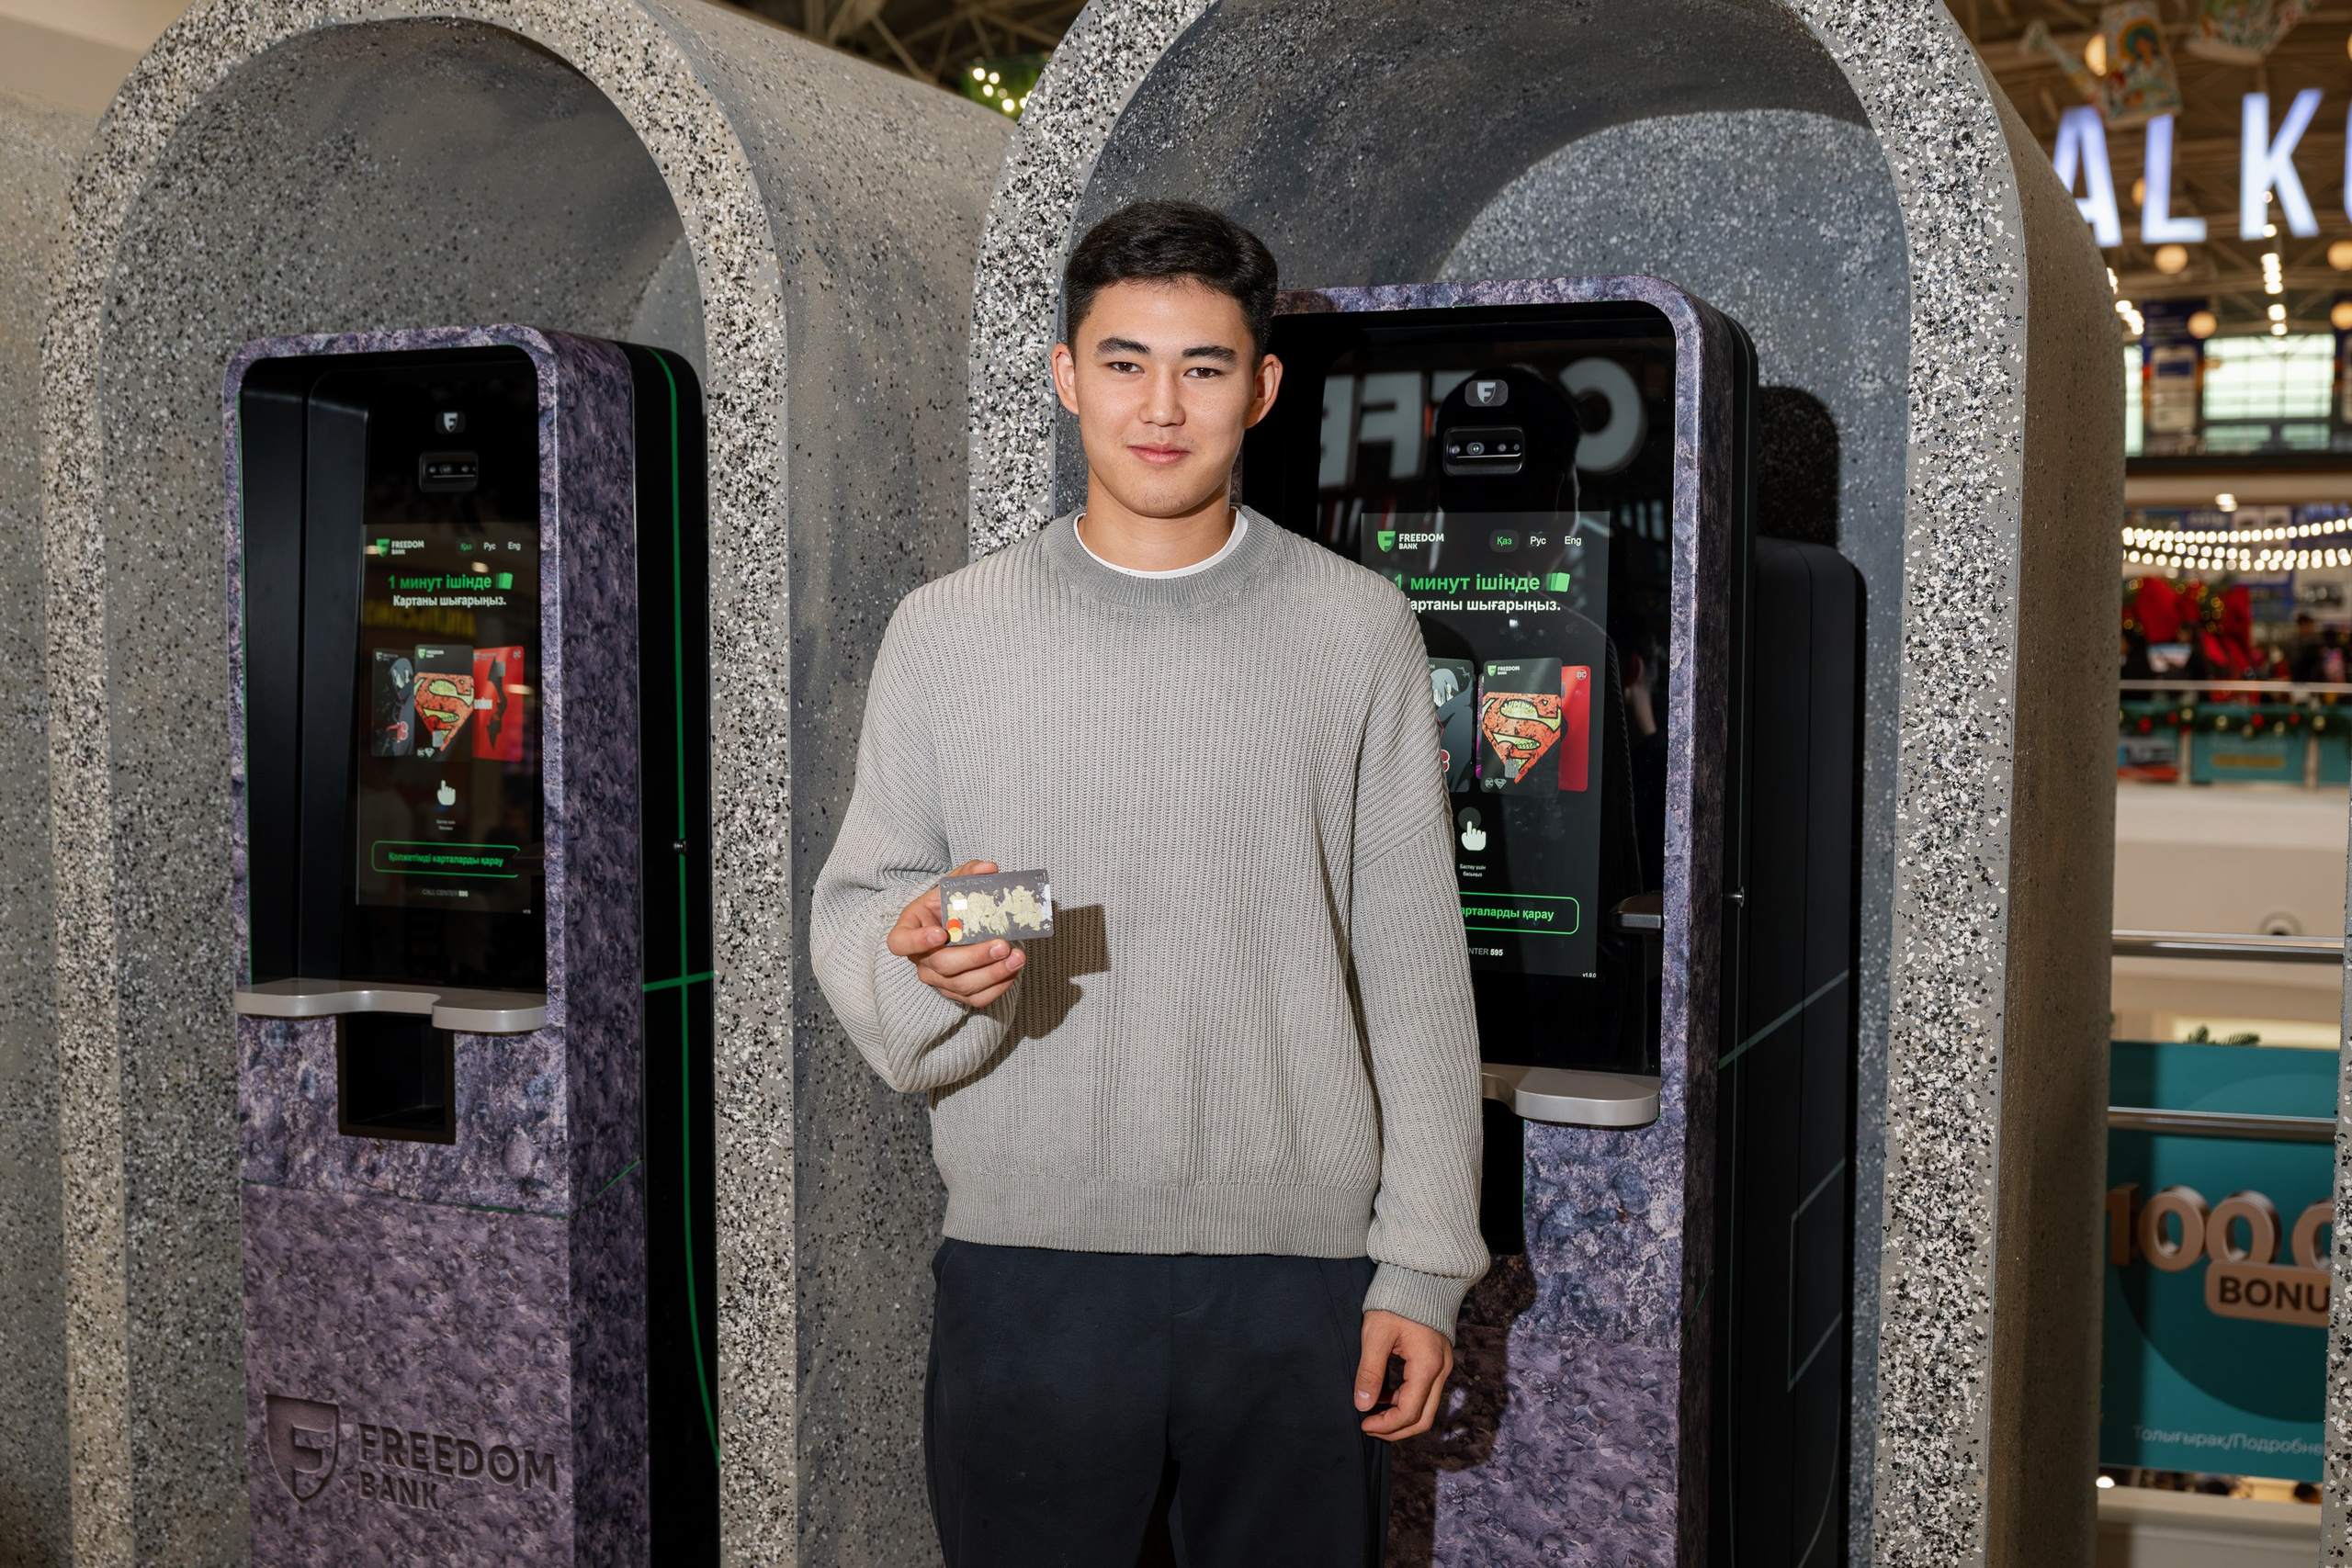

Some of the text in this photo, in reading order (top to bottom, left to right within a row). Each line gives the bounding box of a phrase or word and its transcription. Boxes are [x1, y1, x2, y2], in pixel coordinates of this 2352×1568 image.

[2052, 87, 2352, 248] ALK
[1398, 533, 1444, 543] FREEDOM
[1497, 536, 1546, 547] Қаз Рус
[1565, 536, 1582, 547] Eng
[483, 542, 496, 551] Рус
[508, 541, 521, 551] Eng
[389, 574, 492, 592] 1 минут ішінде
[1394, 574, 1541, 594] 1 минут ішінде
[393, 595, 507, 608] Картаны шығарыңыз.
[1407, 598, 1561, 614] артаны шығарыңыз.
[1577, 670, 1587, 681] DC
[1461, 907, 1555, 922] арталарды қарау
[1467, 947, 1503, 956] NTER 595
[2220, 1275, 2331, 1314] BONU
[2133, 1425, 2324, 1457] Толығырақ/Подробне
[358, 1423, 556, 1493] FREEDOM
[359, 1471, 439, 1509] BANK
